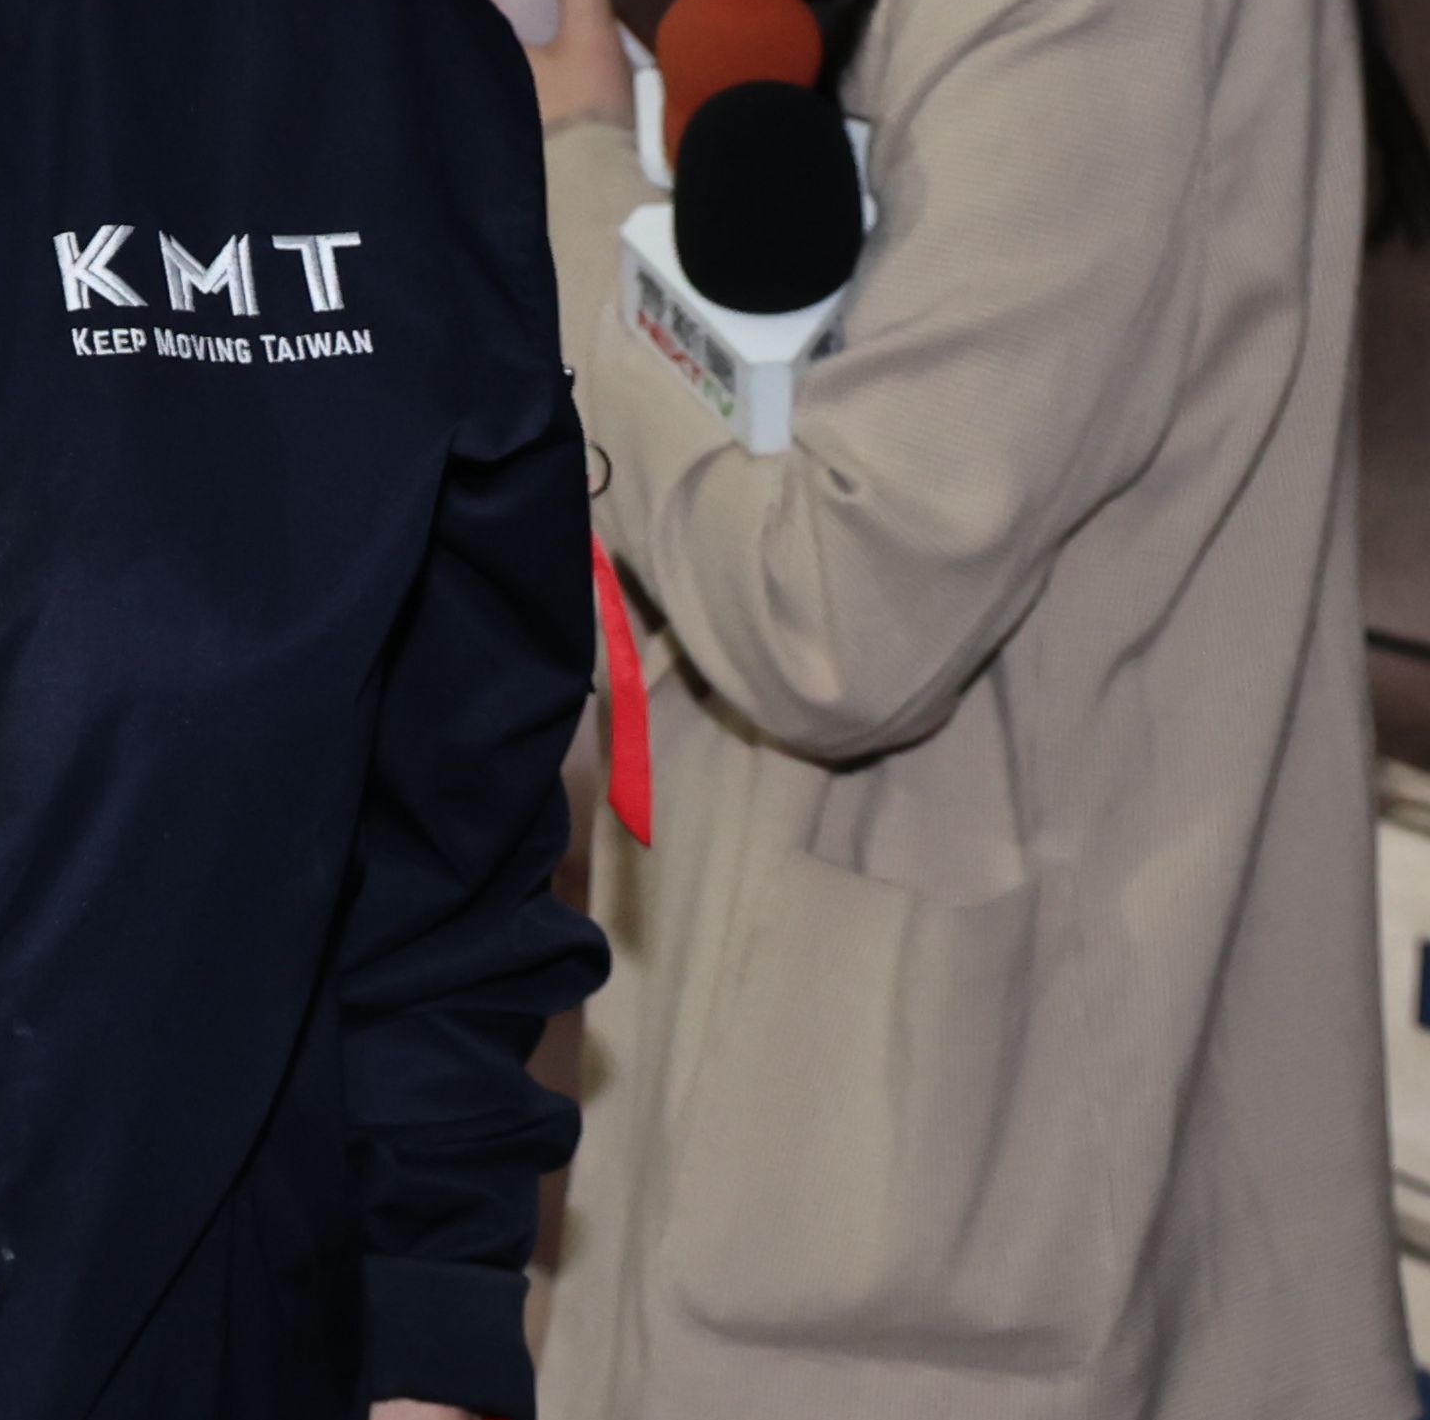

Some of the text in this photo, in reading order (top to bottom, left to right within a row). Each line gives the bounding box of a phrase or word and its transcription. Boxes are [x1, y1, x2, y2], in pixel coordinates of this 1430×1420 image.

[52, 224, 362, 317] KMT
[71, 326, 375, 364] KEEP MOVING TAIWAN
